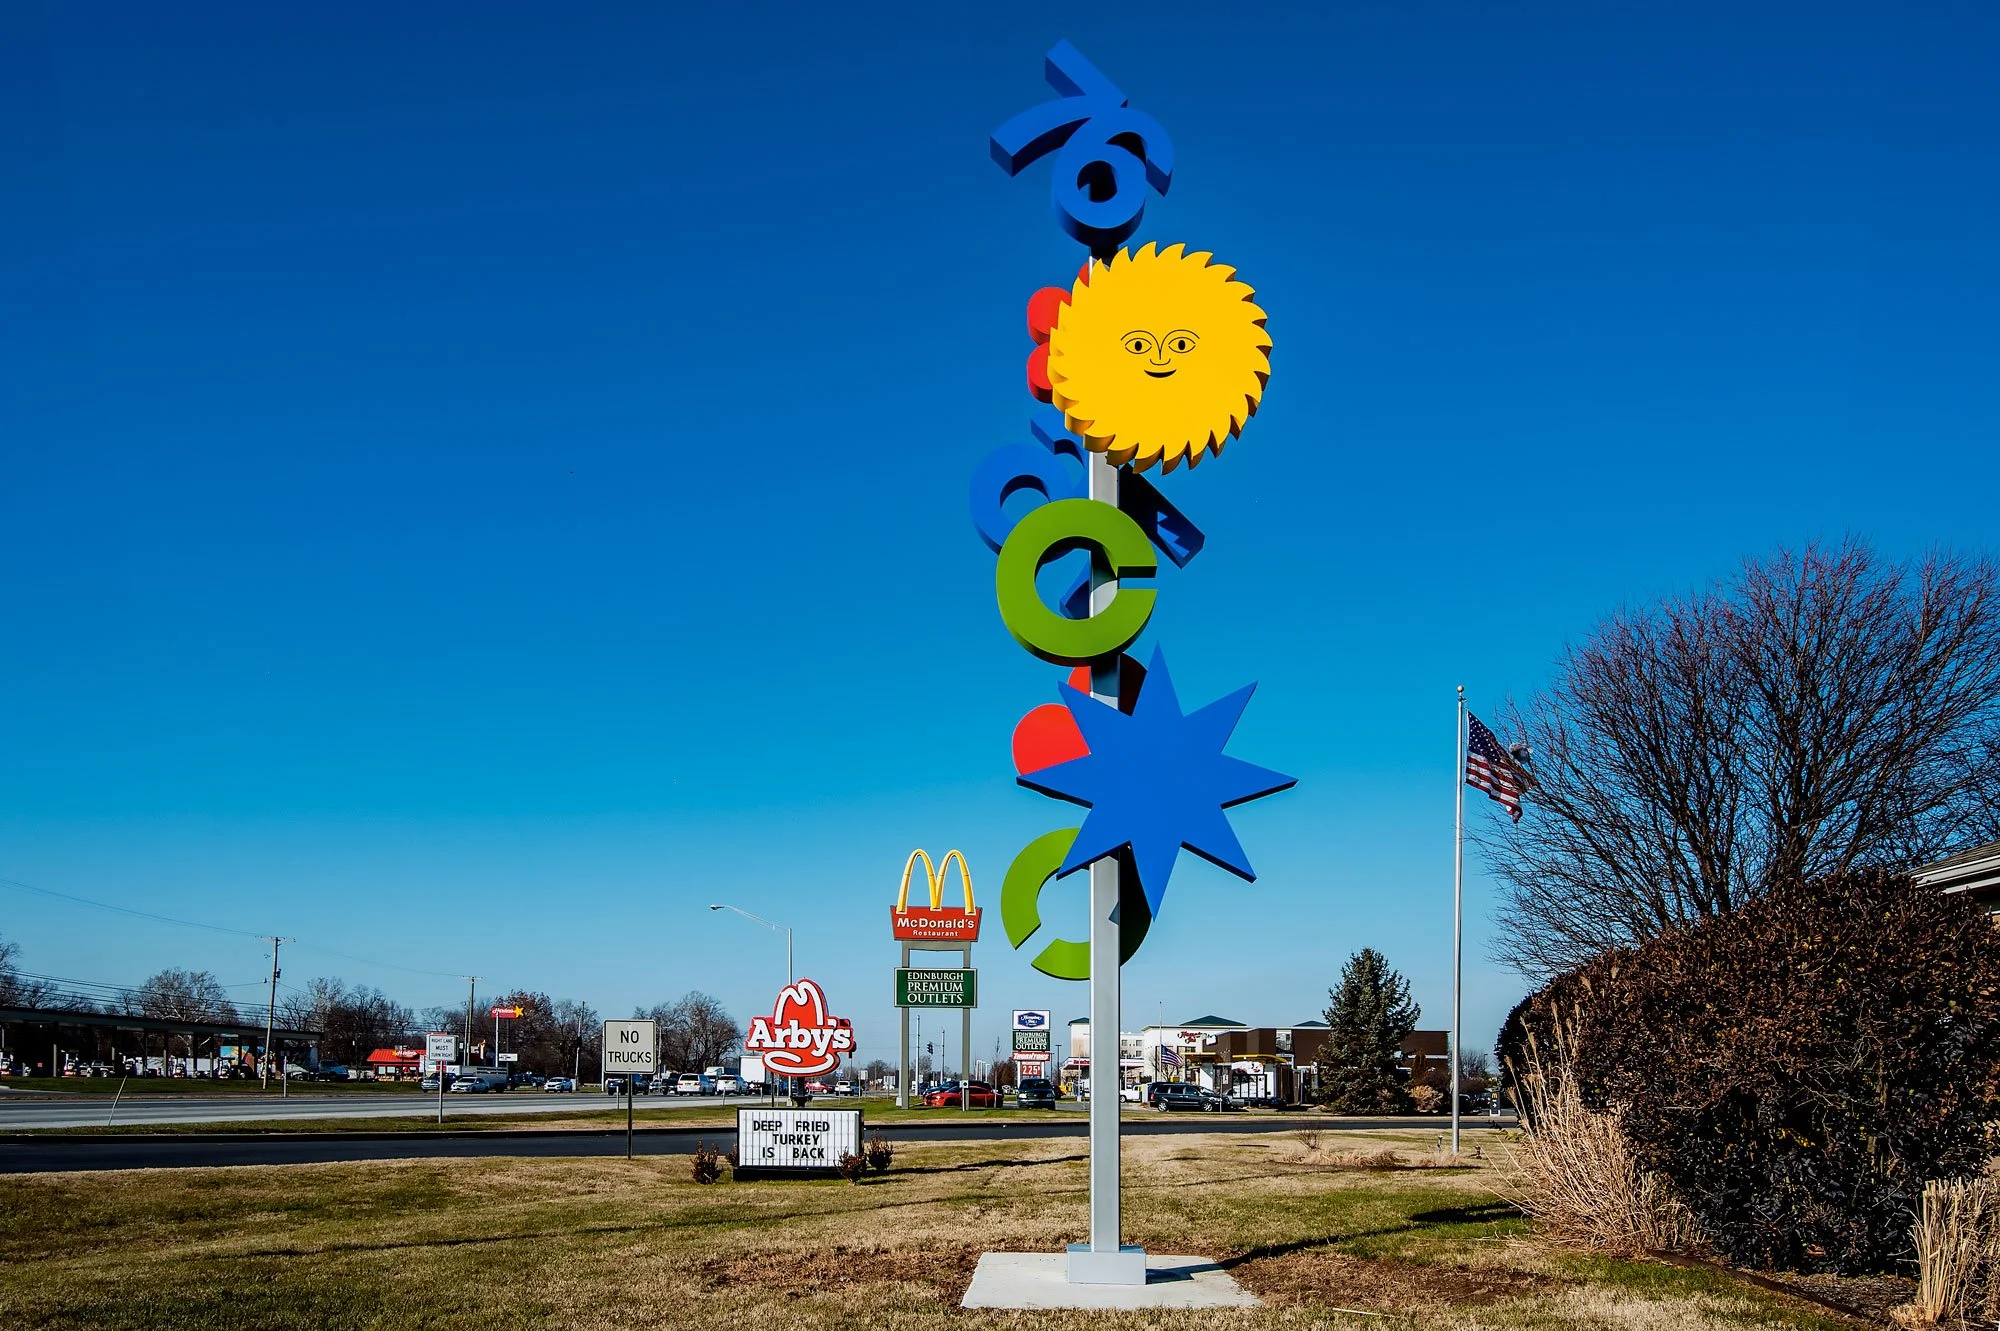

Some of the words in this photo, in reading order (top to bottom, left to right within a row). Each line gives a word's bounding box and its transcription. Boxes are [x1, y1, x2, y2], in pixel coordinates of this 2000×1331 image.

[897, 917, 975, 929] McDonald's
[912, 929, 958, 937] Restaurant
[907, 972, 964, 980] EDINBURGH
[907, 981, 964, 992] PREMIUM
[907, 993, 964, 1004] OUTLETS
[620, 1030, 640, 1044] NO
[747, 1019, 851, 1057] Arby's
[607, 1051, 652, 1064] TRUCKS
[753, 1120, 783, 1131] DEEP
[795, 1120, 830, 1132] FRIED
[772, 1134, 820, 1145] TURKEY
[762, 1147, 775, 1158] IS
[793, 1147, 825, 1159] BACK
